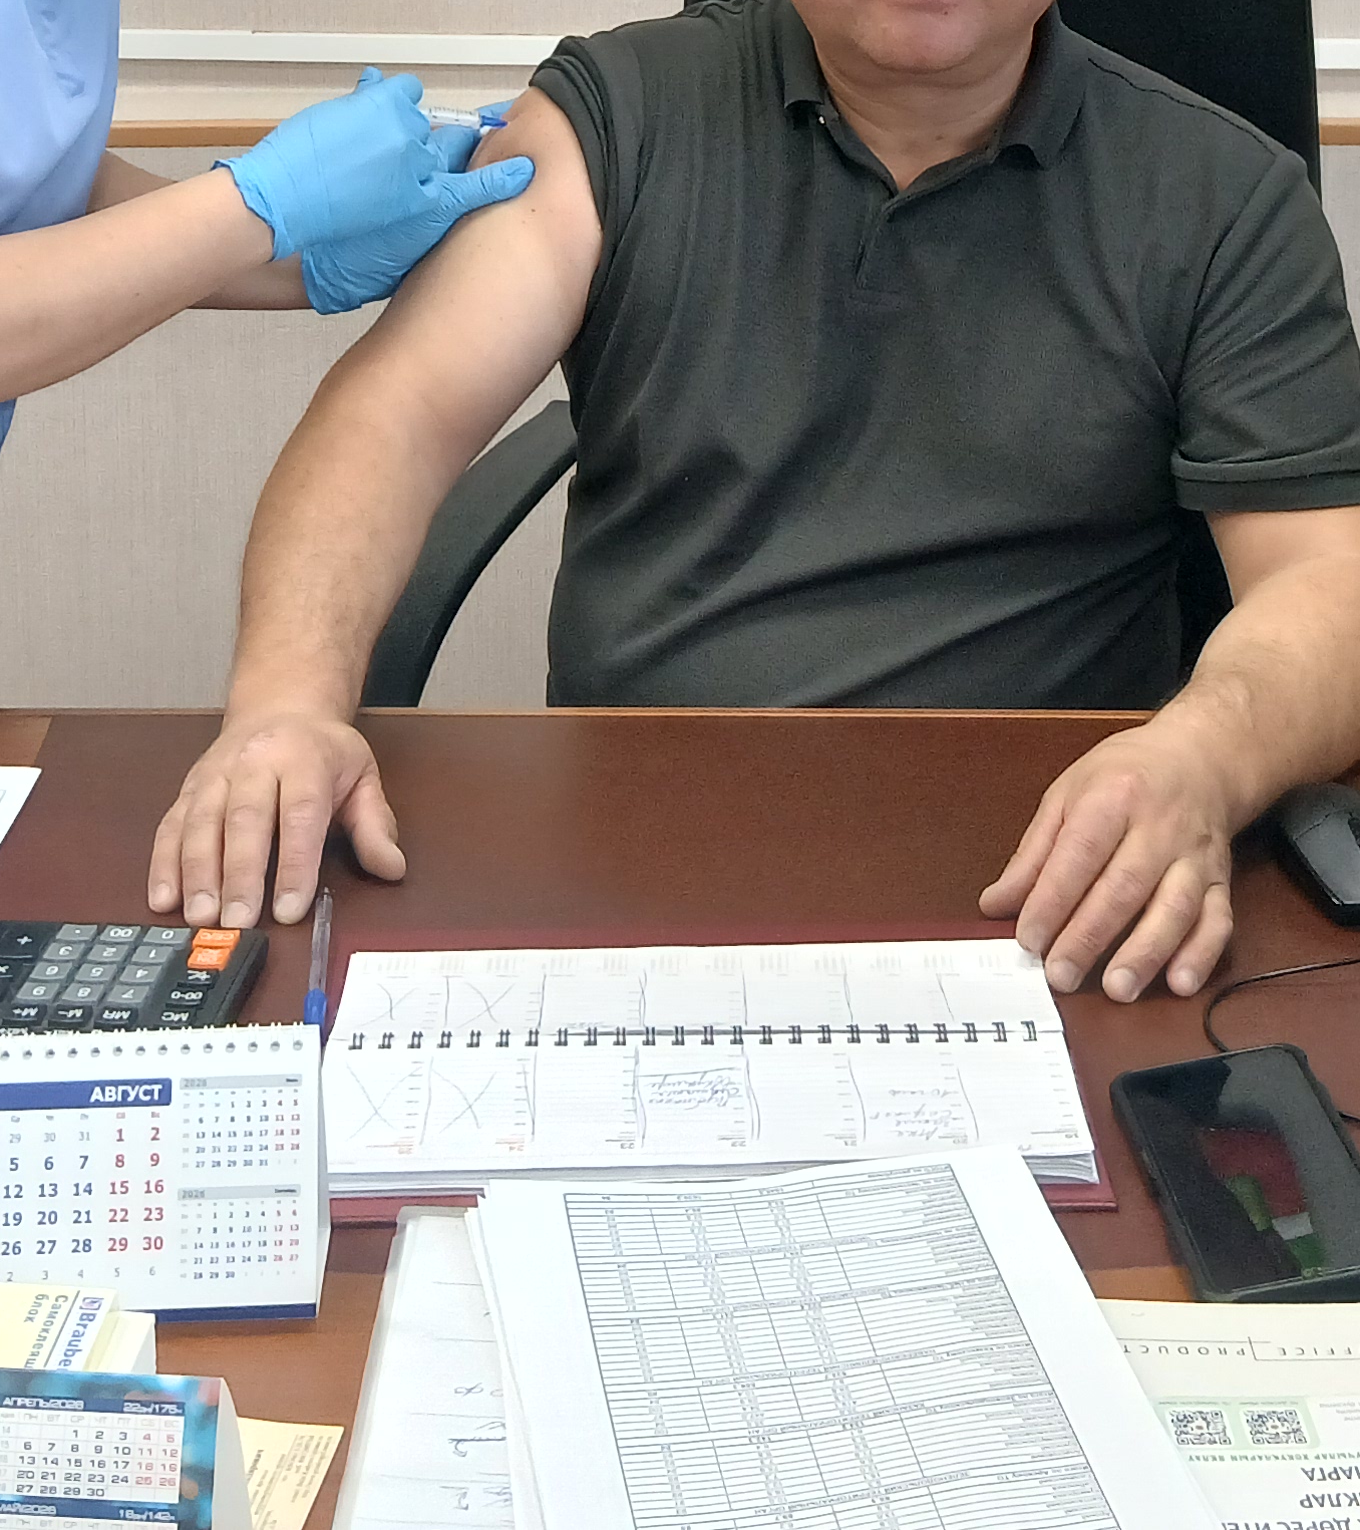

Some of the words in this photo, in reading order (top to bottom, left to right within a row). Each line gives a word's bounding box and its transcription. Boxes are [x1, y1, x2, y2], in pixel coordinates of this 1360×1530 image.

[110, 928, 132, 938] 00
[161, 930, 173, 939] 0
[59, 946, 73, 956] 3
[102, 947, 115, 957] 2
[148, 948, 158, 958] 1
[46, 965, 60, 975] 6
[91, 967, 104, 977] 5
[136, 968, 149, 978] 4
[32, 985, 46, 996] 9
[78, 987, 91, 997] 8
[122, 989, 136, 999] 7
[12, 1006, 38, 1017] M+
[102, 1009, 132, 1019] MR
[161, 1012, 189, 1022] MC
[90, 1085, 162, 1102] АВГУСТ
[116, 1129, 124, 1141] 1
[151, 1127, 160, 1141] 2
[10, 1158, 19, 1171] 5
[44, 1157, 54, 1170] 6
[79, 1155, 89, 1169] 7
[115, 1154, 125, 1168] 8
[150, 1153, 159, 1166] 9
[3, 1184, 23, 1198] 12
[39, 1183, 58, 1197] 13
[73, 1182, 93, 1195] 14
[109, 1181, 129, 1194] 15
[144, 1180, 164, 1193] 16
[2, 1212, 22, 1226] 19
[37, 1211, 57, 1225] 20
[73, 1210, 92, 1223] 21
[108, 1209, 128, 1222] 22
[143, 1207, 164, 1221] 23
[1, 1241, 21, 1255] 26
[36, 1240, 56, 1254] 27
[72, 1239, 92, 1253] 28
[108, 1238, 128, 1251] 29
[143, 1237, 163, 1250] 30
[7, 1272, 14, 1282] 2
[42, 1271, 48, 1280] 3
[78, 1269, 84, 1279] 4
[114, 1268, 120, 1277] 5
[149, 1267, 156, 1276] 6
[24, 1293, 50, 1324] блок
[73, 1430, 79, 1438] 1
[95, 1431, 104, 1440] 2
[119, 1432, 127, 1441] 3
[143, 1433, 151, 1441] 4
[166, 1434, 175, 1442] 5
[24, 1442, 32, 1450] 6
[48, 1443, 56, 1451] 7
[71, 1444, 79, 1453] 8
[94, 1445, 103, 1454] 9
[114, 1447, 131, 1455] 10
[138, 1448, 153, 1456] 11
[162, 1449, 178, 1458] 12
[18, 1456, 36, 1465] 13
[42, 1457, 59, 1466] 14
[66, 1458, 83, 1467] 15
[89, 1459, 106, 1468] 16
[113, 1461, 130, 1469] 17
[17, 1470, 35, 1479] 20
[41, 1472, 57, 1480] 21
[64, 1473, 82, 1482] 22
[88, 1474, 105, 1483] 23
[111, 1475, 129, 1484] 24
[159, 1478, 176, 1486] 26
[16, 1484, 34, 1493] 27
[40, 1486, 57, 1494] 28
[63, 1487, 81, 1496] 29
[87, 1488, 105, 1497] 30
